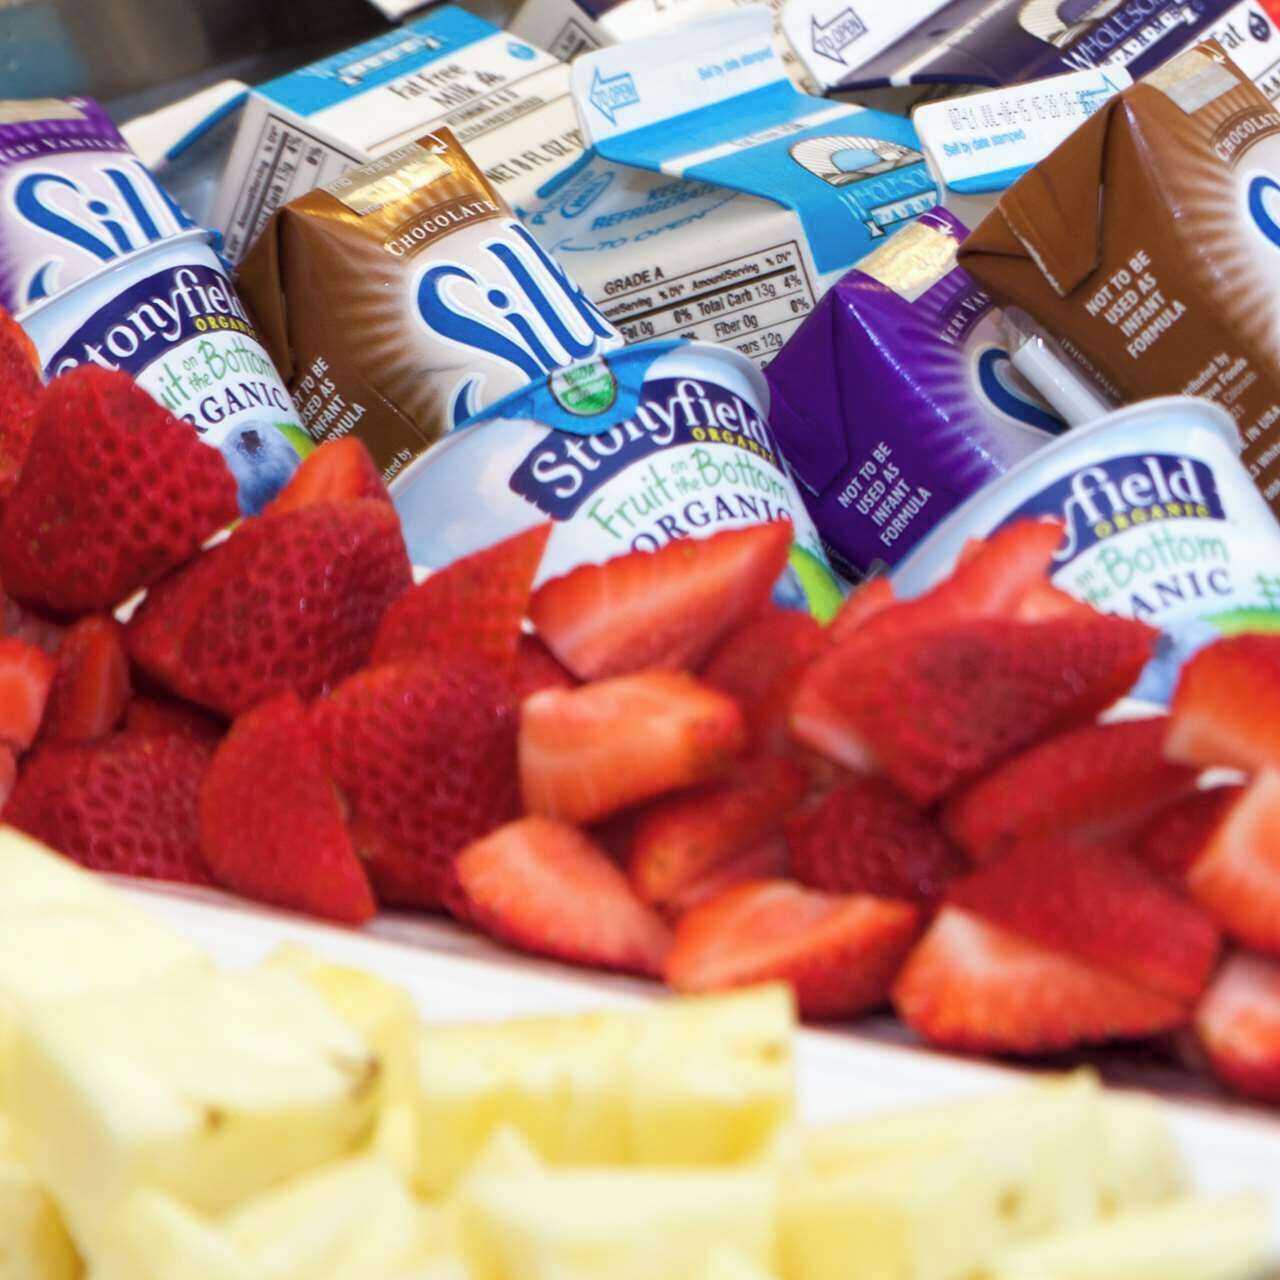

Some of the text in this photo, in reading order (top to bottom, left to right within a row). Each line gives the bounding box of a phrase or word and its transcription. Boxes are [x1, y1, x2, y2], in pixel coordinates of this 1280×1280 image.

[816, 17, 863, 56] TO OPEN
[430, 82, 481, 107] Milk
[384, 199, 500, 257] CHOCOLATE
[603, 266, 664, 295] GRADE A
[698, 272, 804, 318] Total Carb 13g 4%
[1086, 250, 1151, 317] NOT TO BE
[1104, 272, 1156, 325] USED AS
[713, 316, 742, 338] Fiber
[939, 307, 971, 347] VERY
[1120, 290, 1166, 337] INFANT
[1126, 299, 1187, 359] FORMULA
[198, 339, 278, 381] Bottom
[311, 357, 330, 378] BE
[320, 377, 336, 399] AS
[310, 394, 346, 440] INFANT
[588, 446, 793, 539] Fruit Bottom
[837, 441, 892, 508] NOT TO BE
[856, 463, 900, 515] USED AS
[872, 479, 911, 527] INFANT
[880, 487, 932, 547] FORMULA
[1096, 527, 1231, 589] Bottom
[1130, 567, 1234, 620] ANIC
